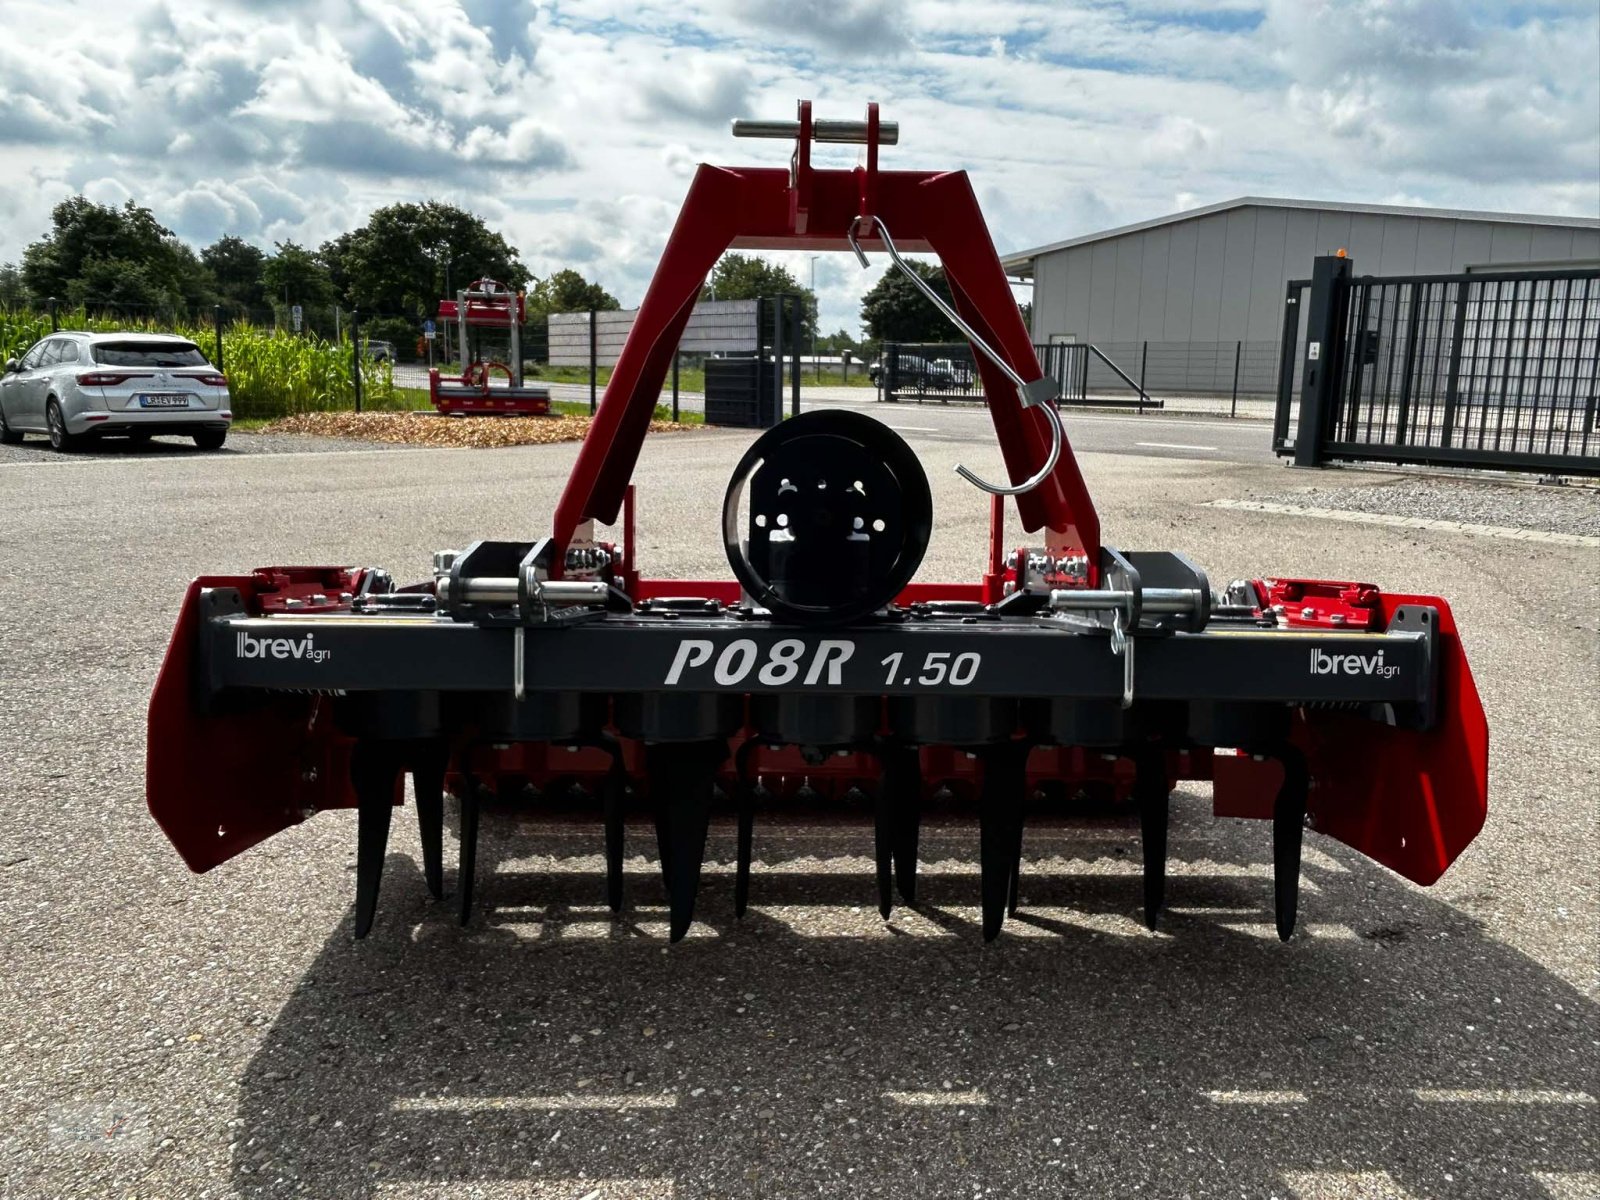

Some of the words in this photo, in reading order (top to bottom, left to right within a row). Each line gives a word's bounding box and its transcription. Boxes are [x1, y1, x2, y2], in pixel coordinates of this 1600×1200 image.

[306, 650, 331, 663] agri
[663, 638, 856, 686] P08R
[880, 652, 982, 686] 1.50
[1376, 666, 1400, 679] agri
